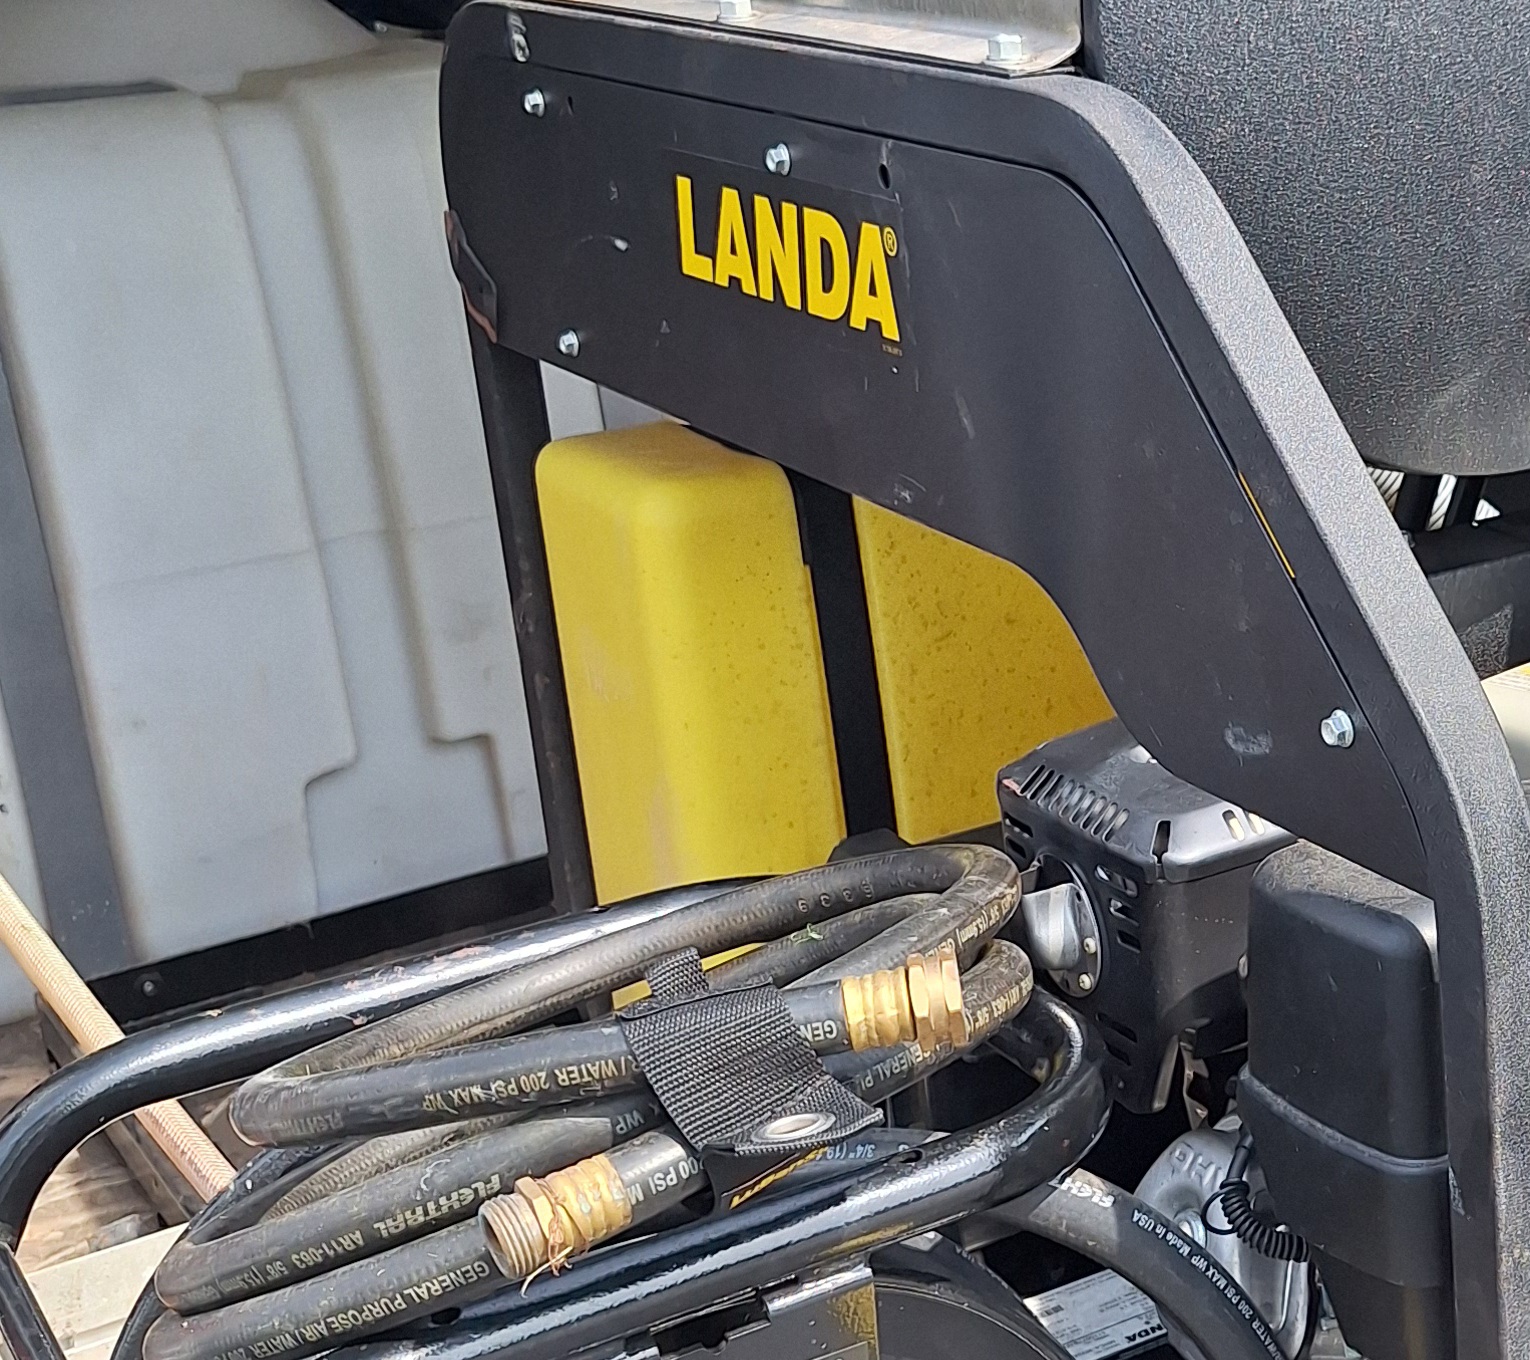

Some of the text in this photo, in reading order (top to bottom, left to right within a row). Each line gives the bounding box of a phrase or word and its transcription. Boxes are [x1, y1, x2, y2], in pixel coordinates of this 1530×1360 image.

[519, 1071, 550, 1093] 200
[555, 1058, 619, 1087] WATER
[615, 1109, 646, 1135] WP
[679, 1153, 704, 1181] 00
[649, 1165, 678, 1196] PSI
[1131, 1208, 1155, 1232] USA
[291, 1228, 366, 1270] AR11-063
[1165, 1230, 1192, 1257] Made
[1190, 1254, 1208, 1274] WP
[403, 1259, 491, 1306] GENERAL
[1205, 1264, 1228, 1291] MAX
[1223, 1285, 1241, 1304] PSI
[331, 1295, 408, 1333] PURPOSE
[1237, 1299, 1254, 1320] 200
[305, 1323, 331, 1345] AIR
[1124, 1322, 1164, 1344] NDA
[252, 1336, 298, 1360] WATER
